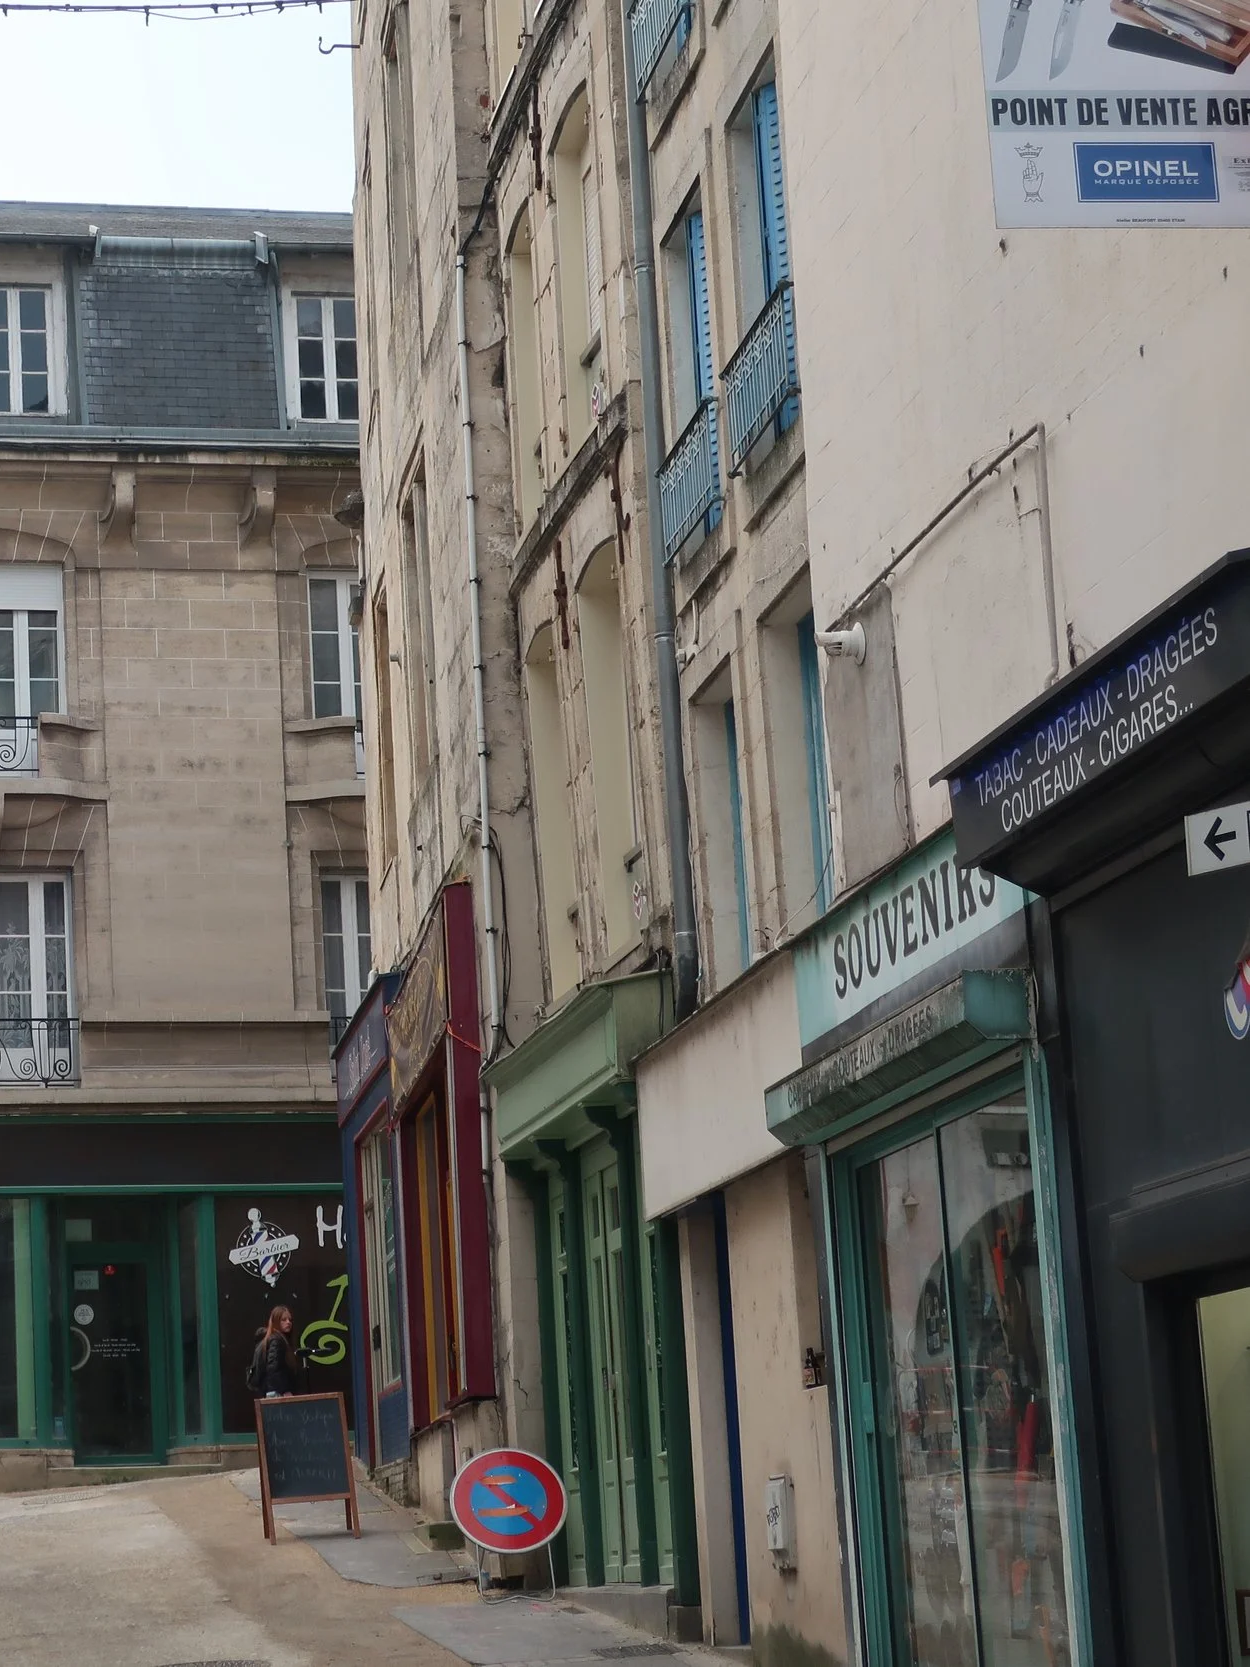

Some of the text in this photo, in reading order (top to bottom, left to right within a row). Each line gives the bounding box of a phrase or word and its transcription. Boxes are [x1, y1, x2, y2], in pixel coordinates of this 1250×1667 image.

[991, 98, 1067, 126] POINT
[1077, 98, 1109, 126] DE
[1116, 98, 1198, 126] VENTE
[1093, 160, 1199, 177] OPINEL
[975, 749, 1023, 806] TABAC
[1035, 681, 1114, 766] CADEAUX
[1127, 607, 1218, 702] DRAGÉES
[1001, 747, 1086, 832] COUTEAUX
[1099, 684, 1194, 767] CIGARES...
[316, 1204, 347, 1249] H
[239, 1242, 290, 1261] Barbier
